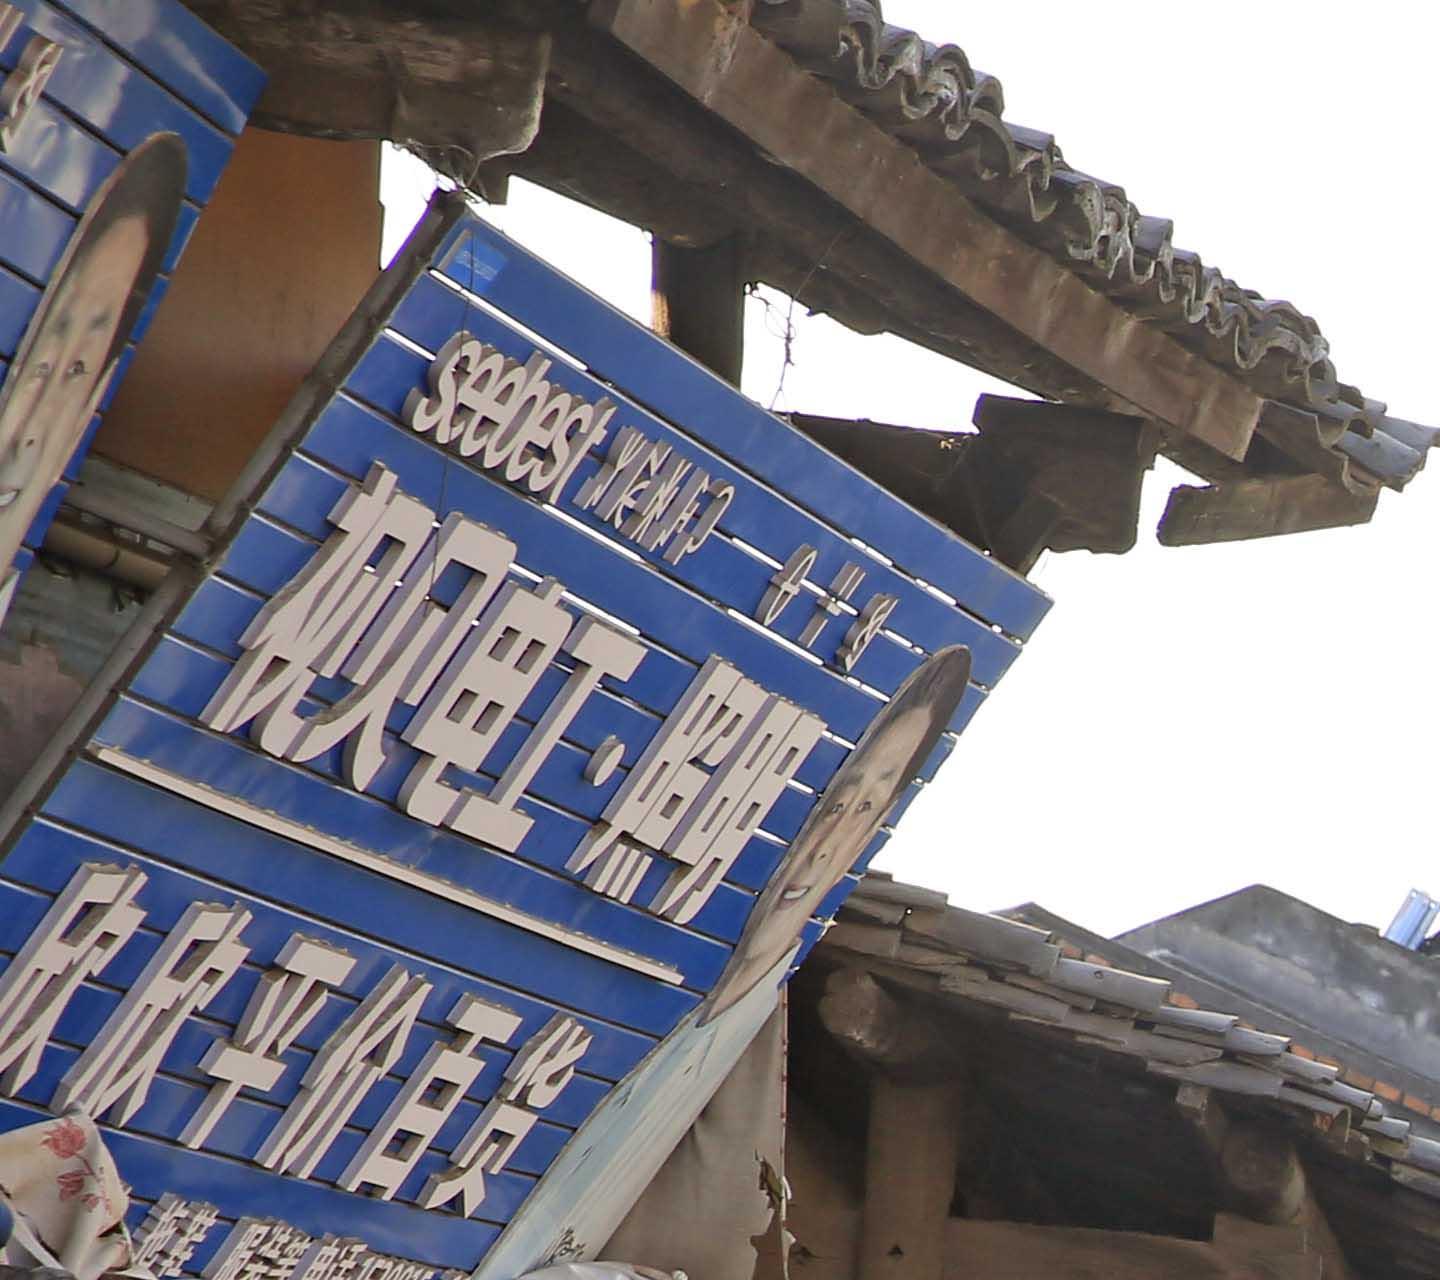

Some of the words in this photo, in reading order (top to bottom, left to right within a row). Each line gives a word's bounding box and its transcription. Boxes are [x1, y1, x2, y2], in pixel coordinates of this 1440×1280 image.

[405, 333, 617, 503] seebest
[0, 862, 592, 1217] 欣欣平价百货
